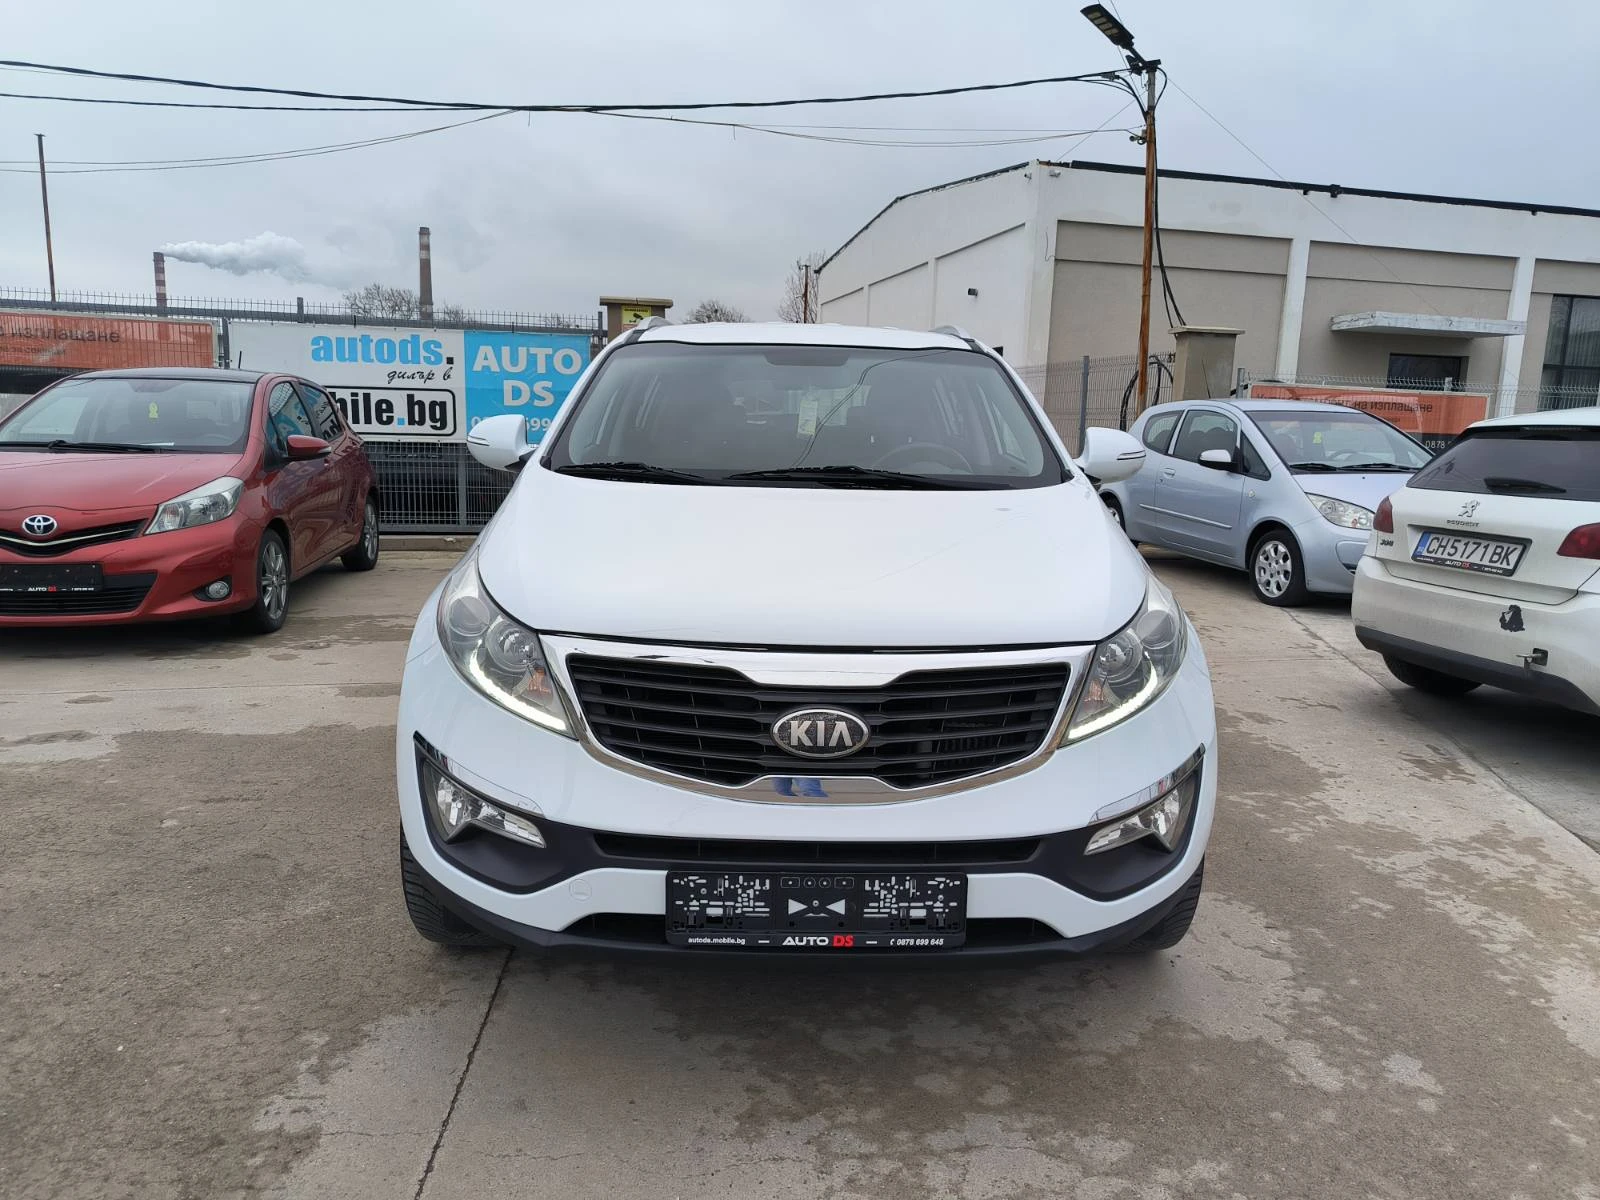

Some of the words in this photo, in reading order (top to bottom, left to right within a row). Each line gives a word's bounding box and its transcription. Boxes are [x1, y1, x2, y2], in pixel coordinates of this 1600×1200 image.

[311, 334, 454, 366] autods.
[472, 345, 582, 375] AUTO
[387, 369, 436, 385] дилър
[503, 379, 555, 407] DS
[1371, 401, 1433, 413] изплащане
[1425, 439, 1446, 449] 0878
[790, 720, 853, 747] KIA
[782, 936, 829, 946] AUTO
[833, 935, 854, 947] DS
[896, 938, 914, 946] 0878
